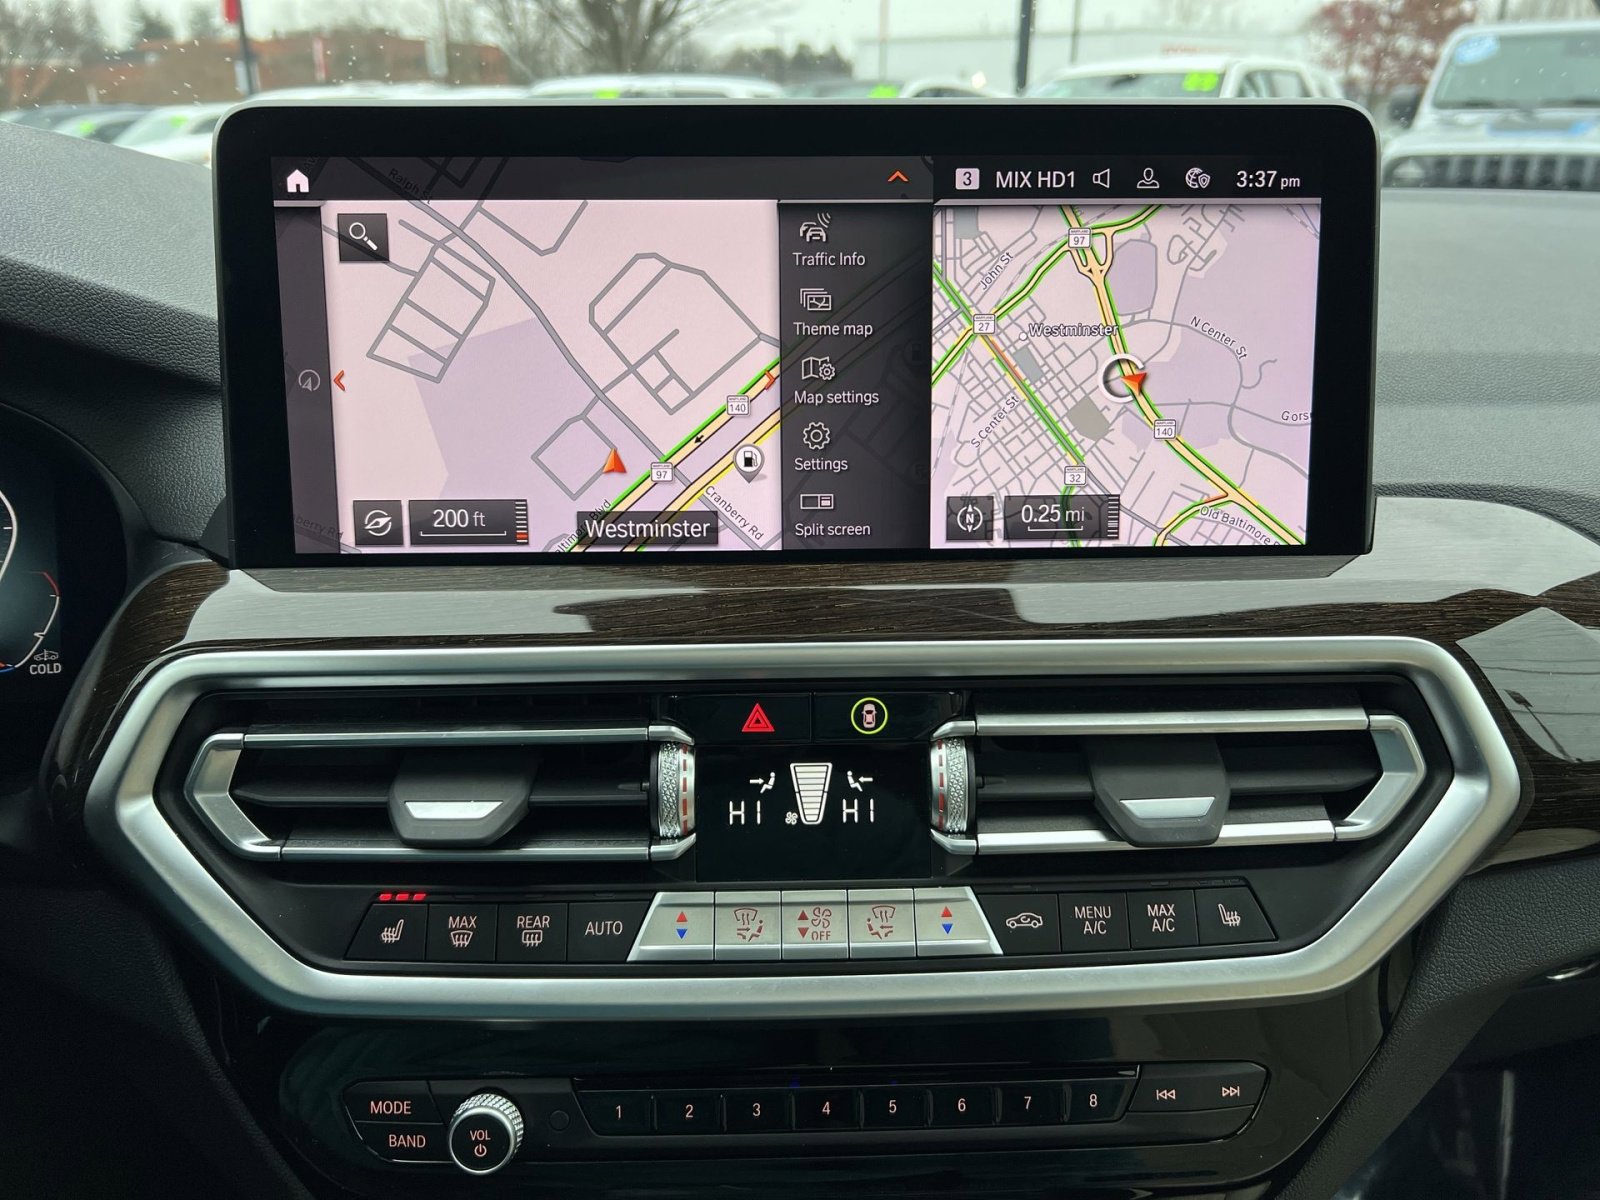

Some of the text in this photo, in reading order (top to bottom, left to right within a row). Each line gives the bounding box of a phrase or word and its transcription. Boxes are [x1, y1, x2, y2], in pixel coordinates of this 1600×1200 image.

[388, 168, 420, 194] Ralph
[963, 172, 972, 186] 3
[996, 171, 1075, 188] MIX HD1
[1236, 171, 1301, 190] 3:37 pm
[1073, 236, 1085, 245] 97
[793, 252, 866, 266] Traffic Info
[981, 252, 1013, 290] John St
[793, 322, 873, 337] Theme map
[978, 322, 990, 332] 27
[1029, 323, 1119, 338] Westminster
[1190, 316, 1247, 359] N Center St
[794, 391, 879, 405] Map settings
[729, 403, 746, 413] 140
[970, 396, 1019, 448] S Center St
[1157, 428, 1173, 436] 140
[794, 458, 848, 473] Settings
[656, 470, 667, 479] 97
[1069, 474, 1081, 482] 32
[433, 509, 485, 527] 200 ft
[705, 486, 764, 540] Cranberry Rd
[1021, 505, 1085, 523] 0.25 mi
[585, 520, 710, 538] Westminster
[795, 523, 870, 537] Split screen
[1200, 506, 1270, 544] Old Baltimore
[29, 663, 62, 674] COLD
[729, 800, 761, 825] HI
[842, 798, 874, 823] HI
[1074, 906, 1112, 919] MENU
[1147, 904, 1175, 917] MAX
[449, 916, 477, 929] MAX
[517, 916, 550, 929] REAR
[585, 921, 623, 936] AUTO
[1084, 921, 1106, 935] A/C
[1152, 918, 1175, 932] A/C
[811, 931, 831, 941] OFF
[370, 1101, 411, 1114] MODE
[888, 1100, 897, 1113] 5
[957, 1098, 966, 1112] 6
[1024, 1096, 1032, 1109] 7
[1089, 1094, 1098, 1107] 8
[615, 1105, 622, 1119] 1
[685, 1104, 694, 1118] 2
[752, 1103, 761, 1117] 3
[822, 1101, 831, 1115] 4
[388, 1134, 426, 1148] BAND
[470, 1130, 491, 1141] VOL
